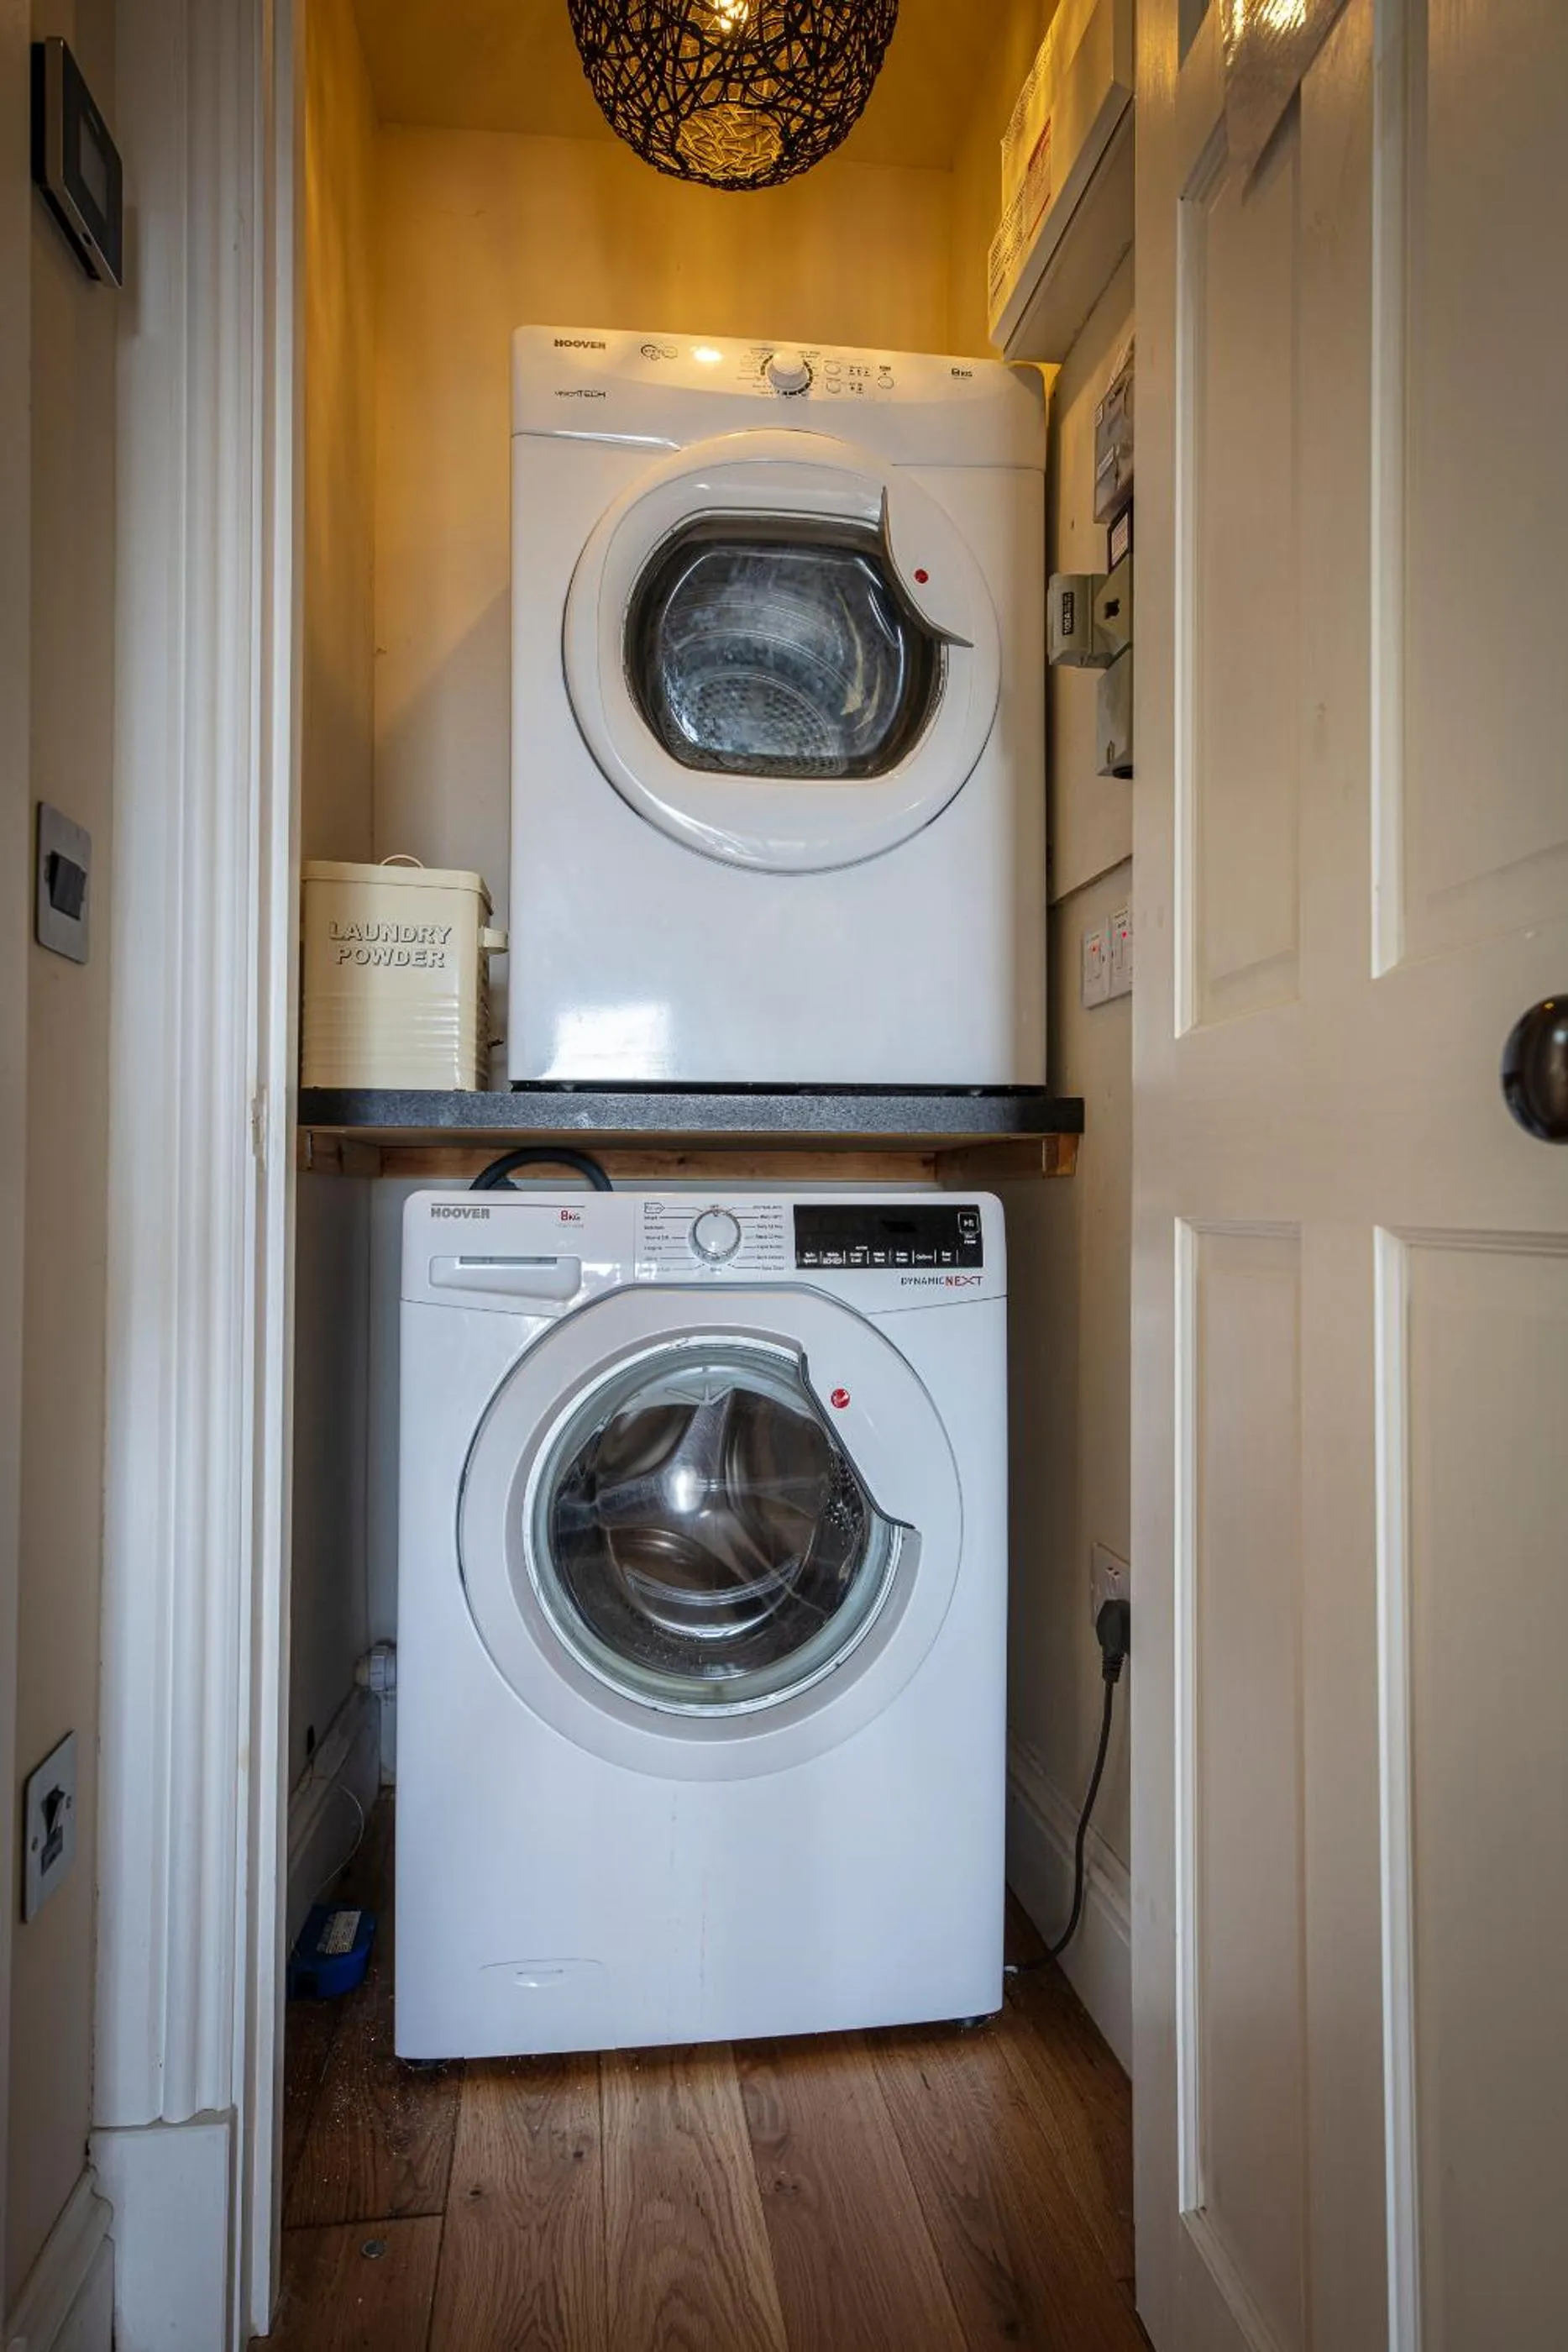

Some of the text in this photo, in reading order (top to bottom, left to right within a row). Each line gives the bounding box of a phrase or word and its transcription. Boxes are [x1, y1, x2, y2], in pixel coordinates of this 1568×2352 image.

[554, 339, 606, 349] HOOVER
[328, 921, 453, 945] LAUNDRY
[336, 946, 446, 969] POWDER
[431, 1207, 490, 1220] HOOVER
